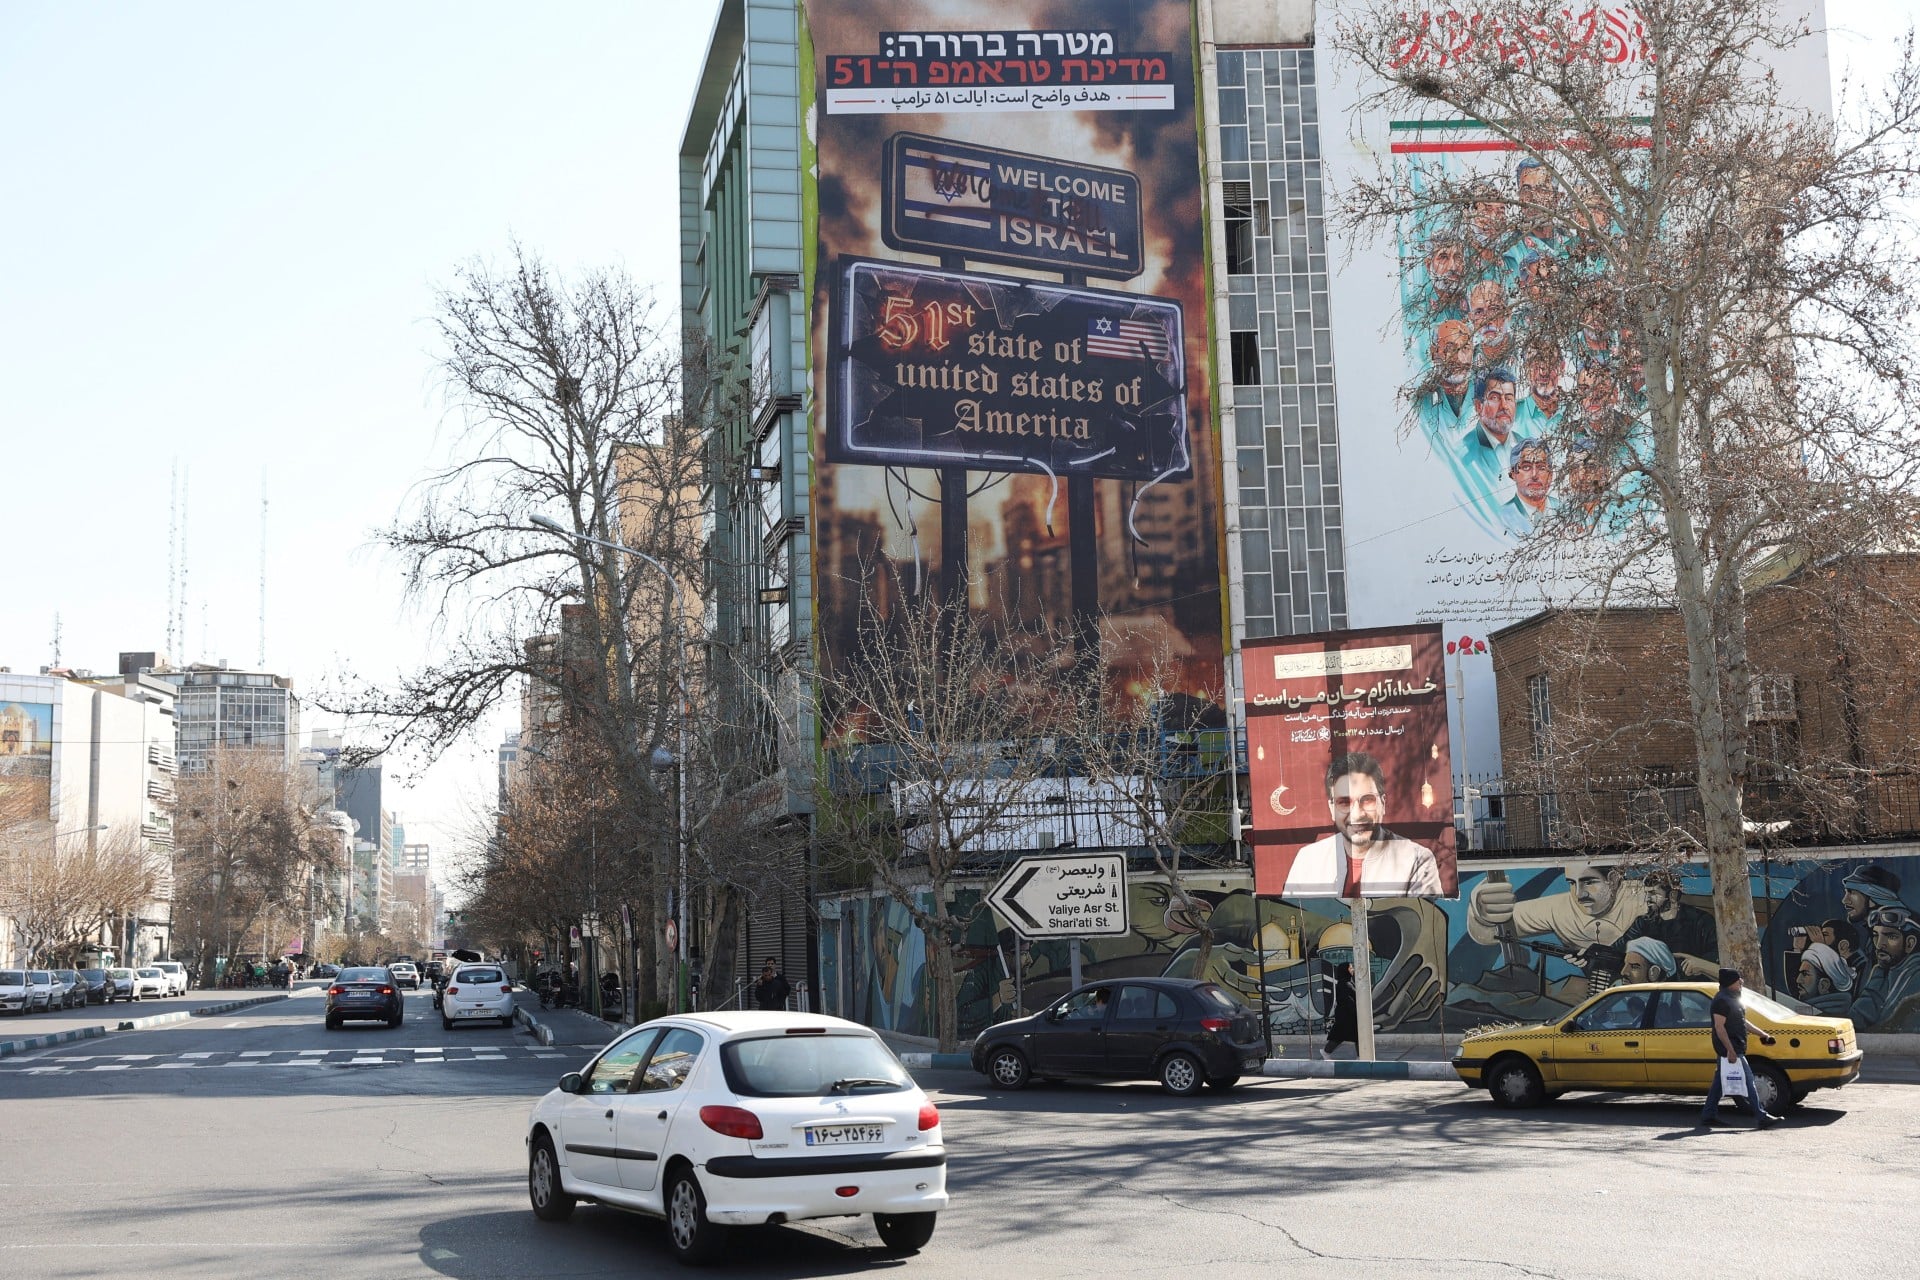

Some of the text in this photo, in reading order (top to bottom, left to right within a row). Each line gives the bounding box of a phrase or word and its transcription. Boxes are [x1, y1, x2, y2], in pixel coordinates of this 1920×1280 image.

[886, 32, 1114, 57] מטרה ברורה:
[928, 60, 1051, 84] טראמפ
[1061, 58, 1166, 82] מדינת
[891, 87, 1111, 110] هدف واضح است: ایالت ۵۱ ترامپ
[998, 164, 1126, 204] WELCOME
[1047, 197, 1081, 221] TO
[1000, 214, 1129, 261] ISRAEL
[967, 330, 1083, 364] state of
[895, 359, 1142, 407] united states of
[954, 399, 1090, 440] America
[1253, 688, 1287, 707] است
[1288, 691, 1325, 709] من
[1327, 685, 1367, 706] جان
[1367, 679, 1392, 706] آرام
[1284, 712, 1303, 722] است
[1385, 725, 1405, 736] ارسال
[1059, 863, 1105, 880] ولیعصر
[1056, 882, 1106, 900] شریعتی
[1048, 902, 1119, 916] Valiye Asr St.
[1048, 917, 1110, 928] Shari'ati St.
